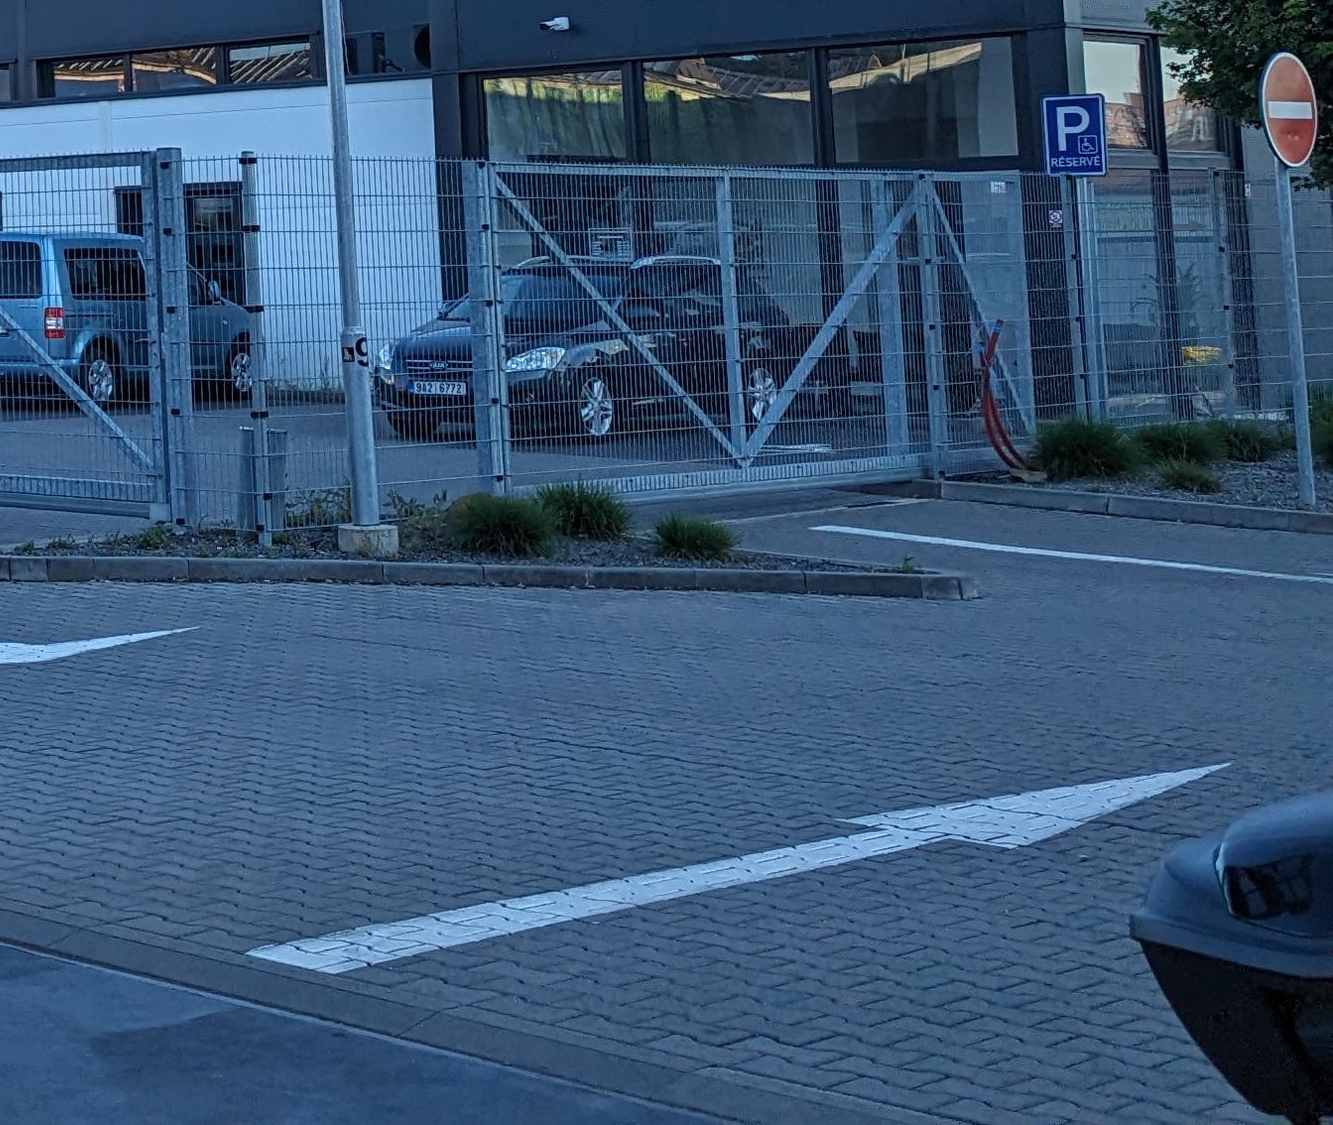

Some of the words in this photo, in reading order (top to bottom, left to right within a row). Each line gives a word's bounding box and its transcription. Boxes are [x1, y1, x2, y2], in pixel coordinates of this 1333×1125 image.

[1056, 106, 1090, 151] P
[355, 337, 369, 367] 9
[439, 383, 462, 395] 6772
